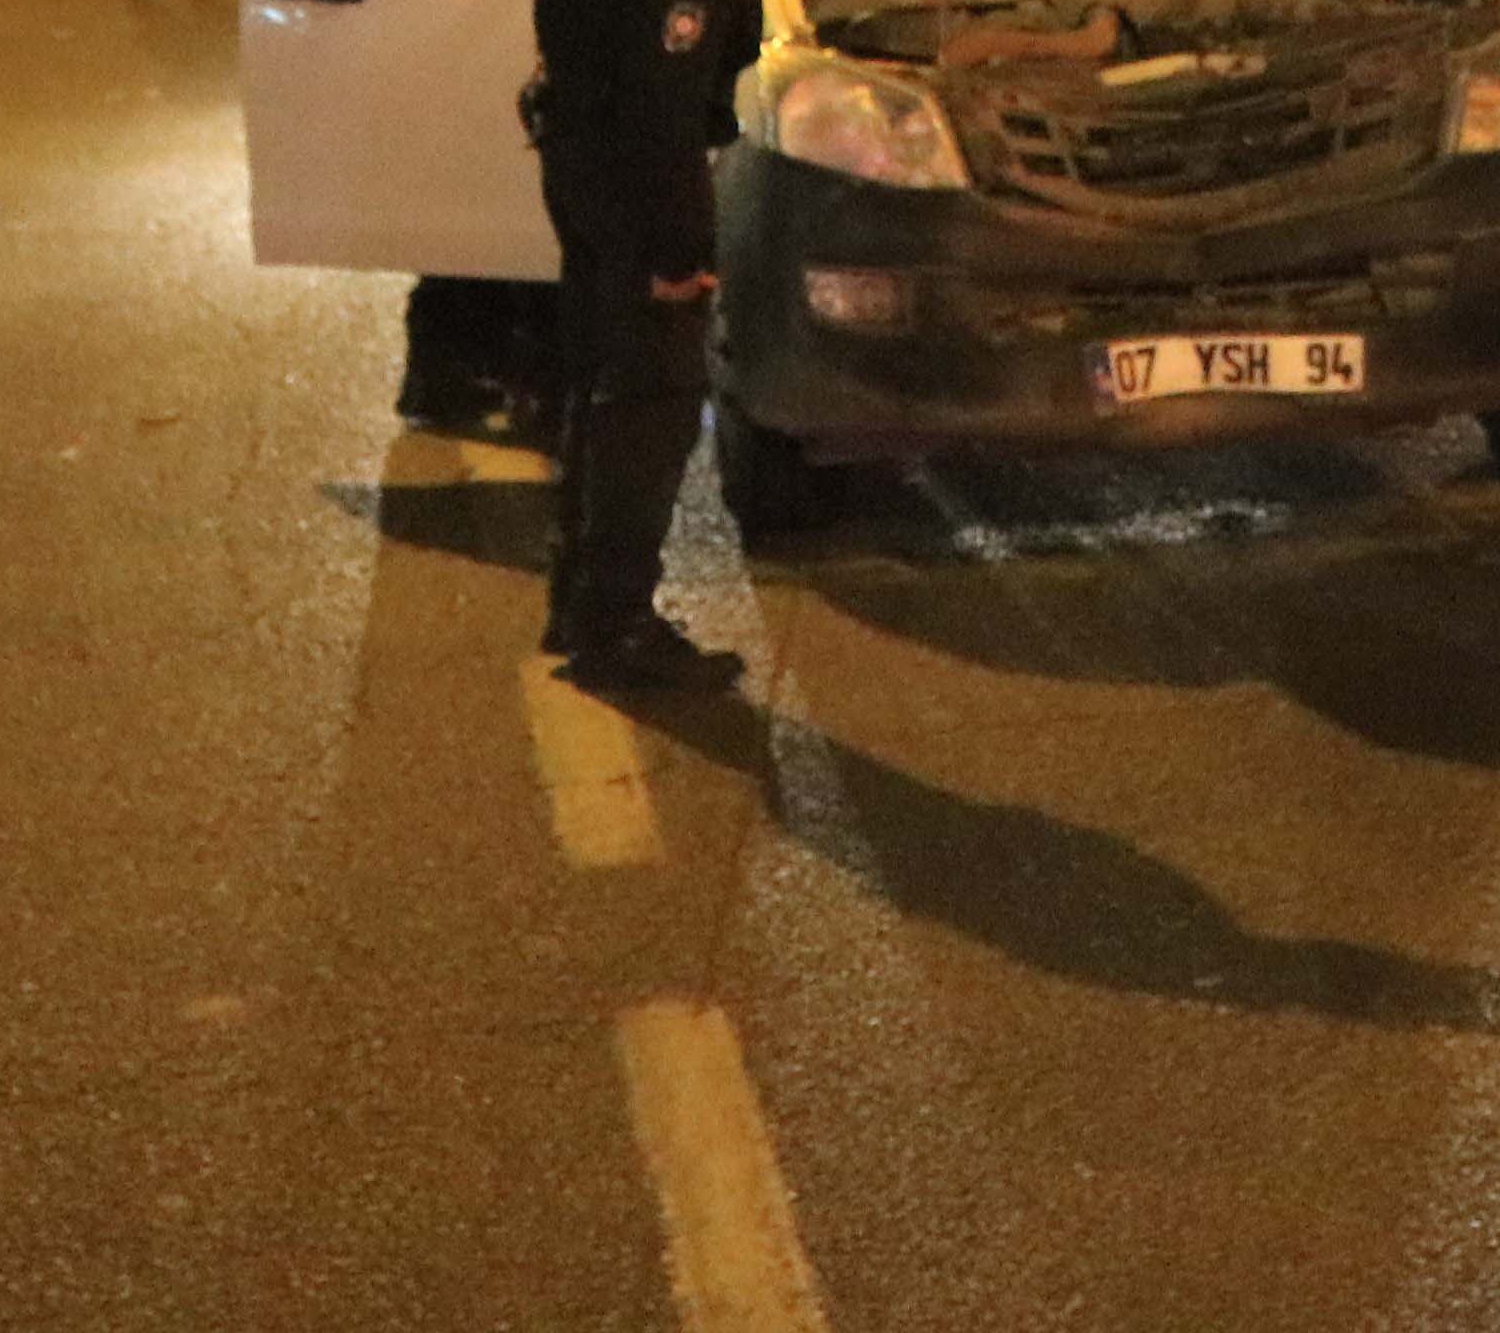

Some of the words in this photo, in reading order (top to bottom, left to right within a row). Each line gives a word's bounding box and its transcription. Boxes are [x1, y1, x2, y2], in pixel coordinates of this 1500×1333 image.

[1114, 345, 1157, 395] 07
[1194, 342, 1270, 385] YSH
[1304, 342, 1353, 385] 94
